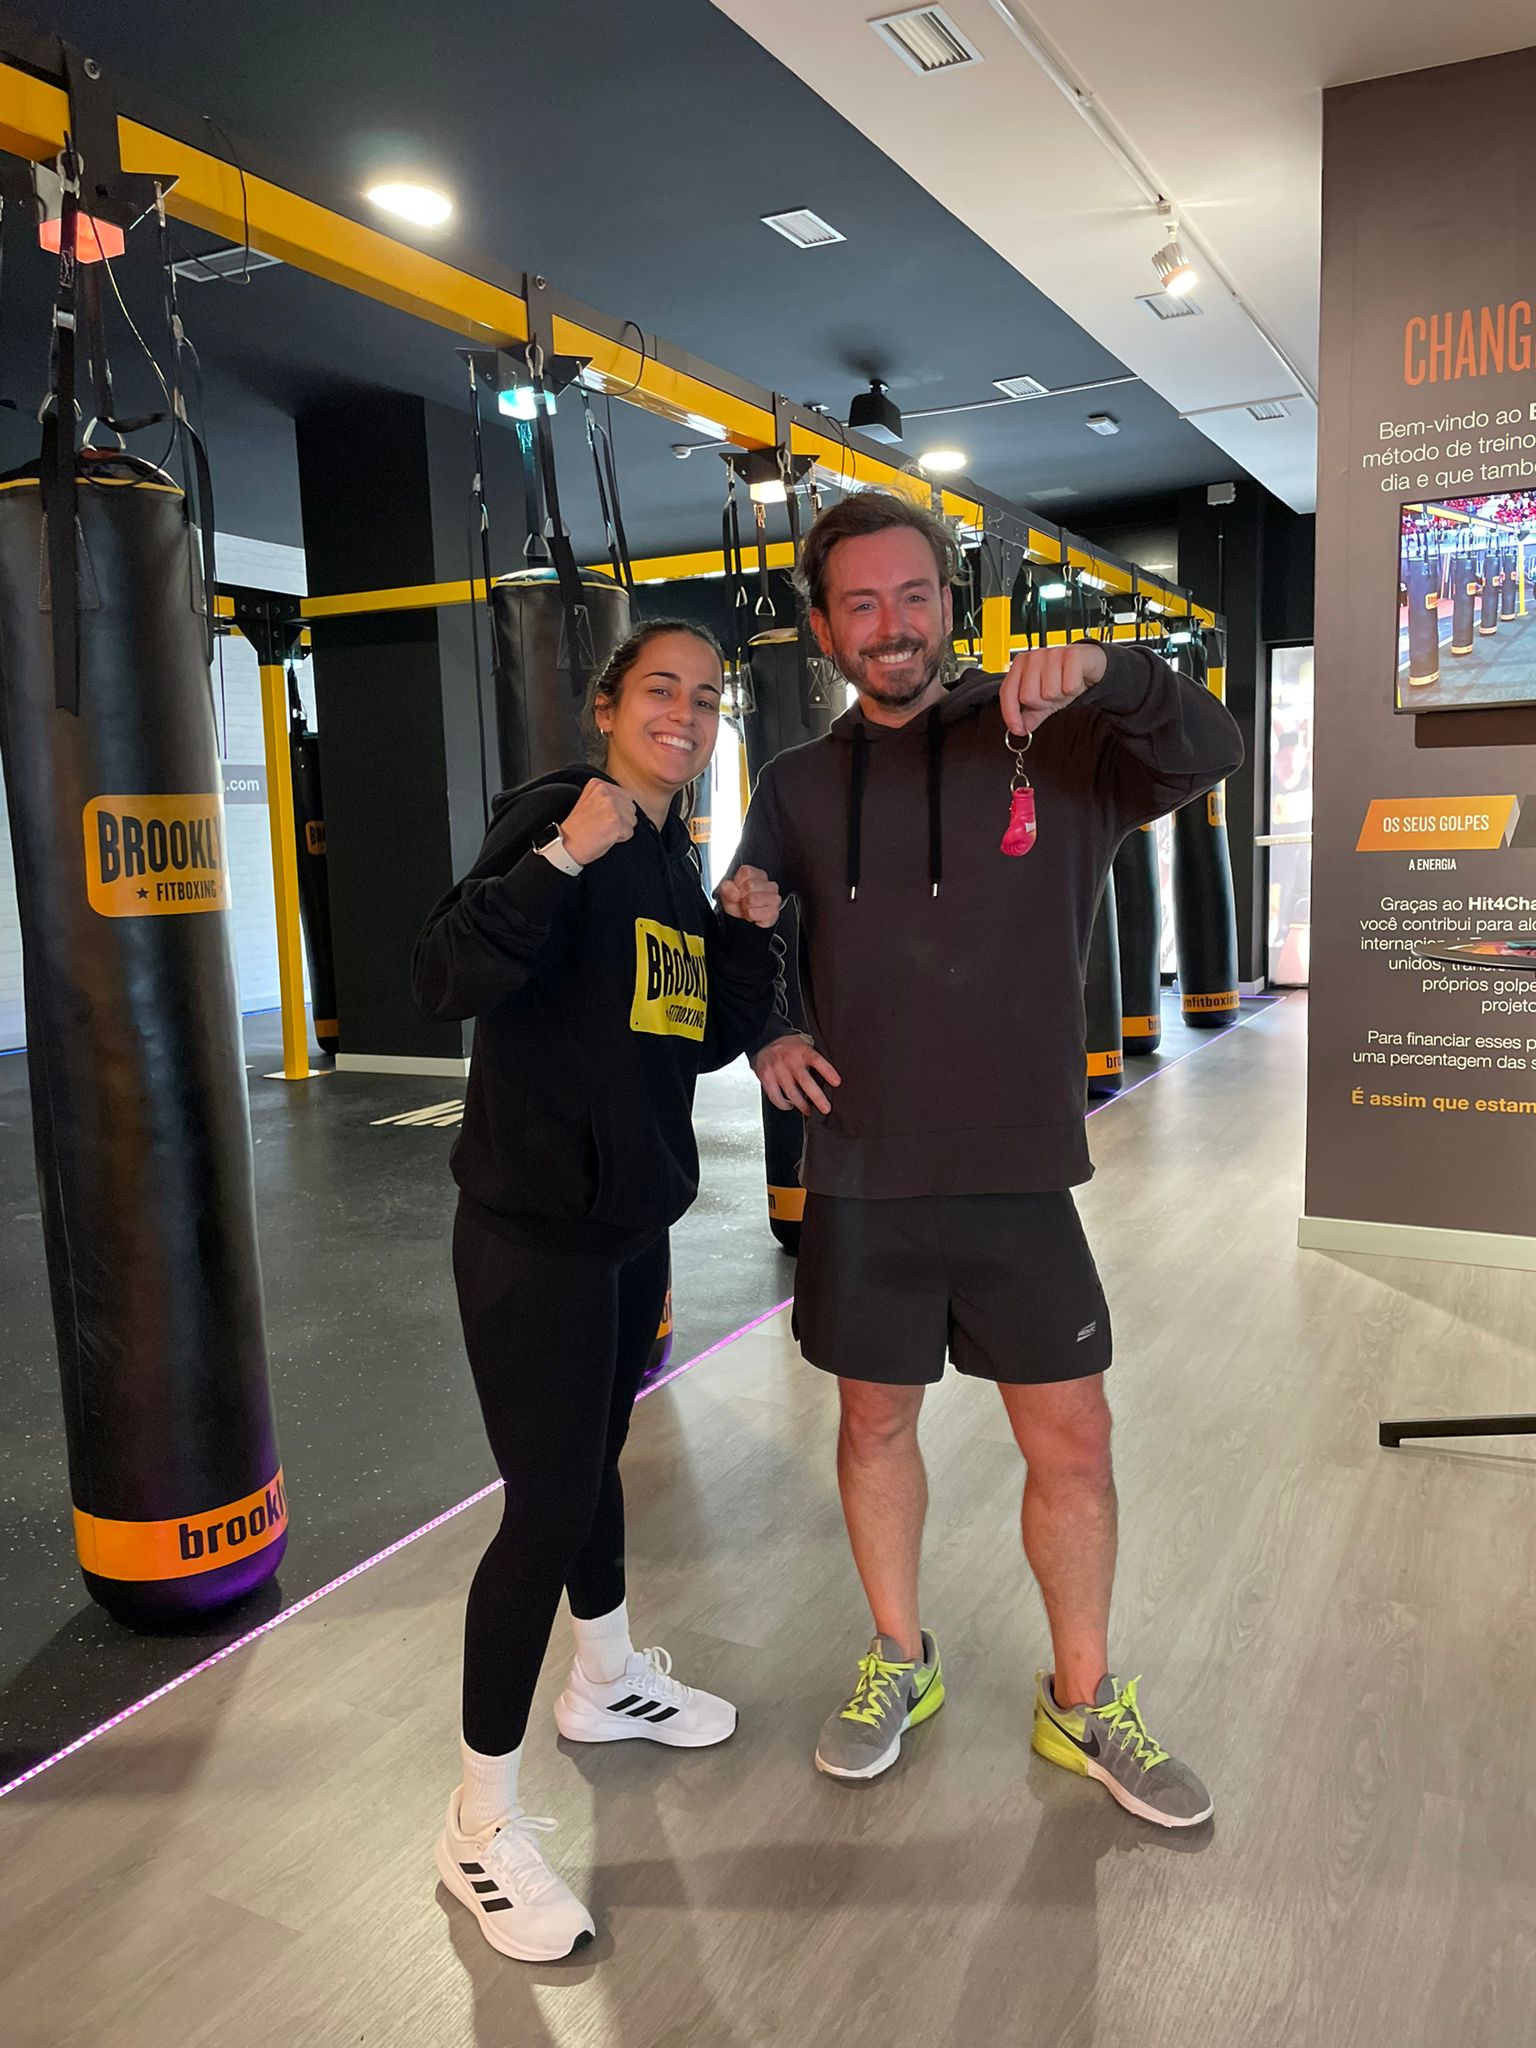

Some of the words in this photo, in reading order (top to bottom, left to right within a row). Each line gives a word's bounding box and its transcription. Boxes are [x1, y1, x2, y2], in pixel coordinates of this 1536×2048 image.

[1403, 300, 1536, 386] CHANG
[1379, 411, 1489, 440] Bem-vindo
[1495, 408, 1522, 425] ao
[1362, 444, 1440, 468] método
[1446, 440, 1472, 458] de
[1478, 432, 1536, 454] treino
[1380, 474, 1411, 492] dia
[1416, 474, 1429, 488] e
[1435, 468, 1474, 489] que
[222, 777, 260, 792] .com
[1383, 817, 1400, 833] OS
[1402, 816, 1436, 832] SEUS
[1439, 814, 1489, 831] GOLPES
[1408, 859, 1416, 871] A
[1416, 858, 1457, 871] ENERGIA
[156, 880, 217, 902] FITBOXING
[1380, 897, 1438, 914] Graças
[1442, 899, 1463, 911] ao
[1360, 918, 1398, 931] você
[1402, 917, 1471, 931] contribui
[1476, 920, 1513, 934] para
[1388, 957, 1446, 973] unidos,
[1422, 976, 1489, 993] próprios
[1367, 1030, 1404, 1045] Para
[1406, 1031, 1471, 1047] financiar
[1475, 1036, 1522, 1049] esses
[1352, 1052, 1387, 1064] uma
[1390, 1052, 1492, 1070] percentagem
[1496, 1054, 1528, 1070] das
[1351, 1087, 1364, 1105] É
[1369, 1091, 1427, 1108] assim
[1432, 1096, 1469, 1114] que
